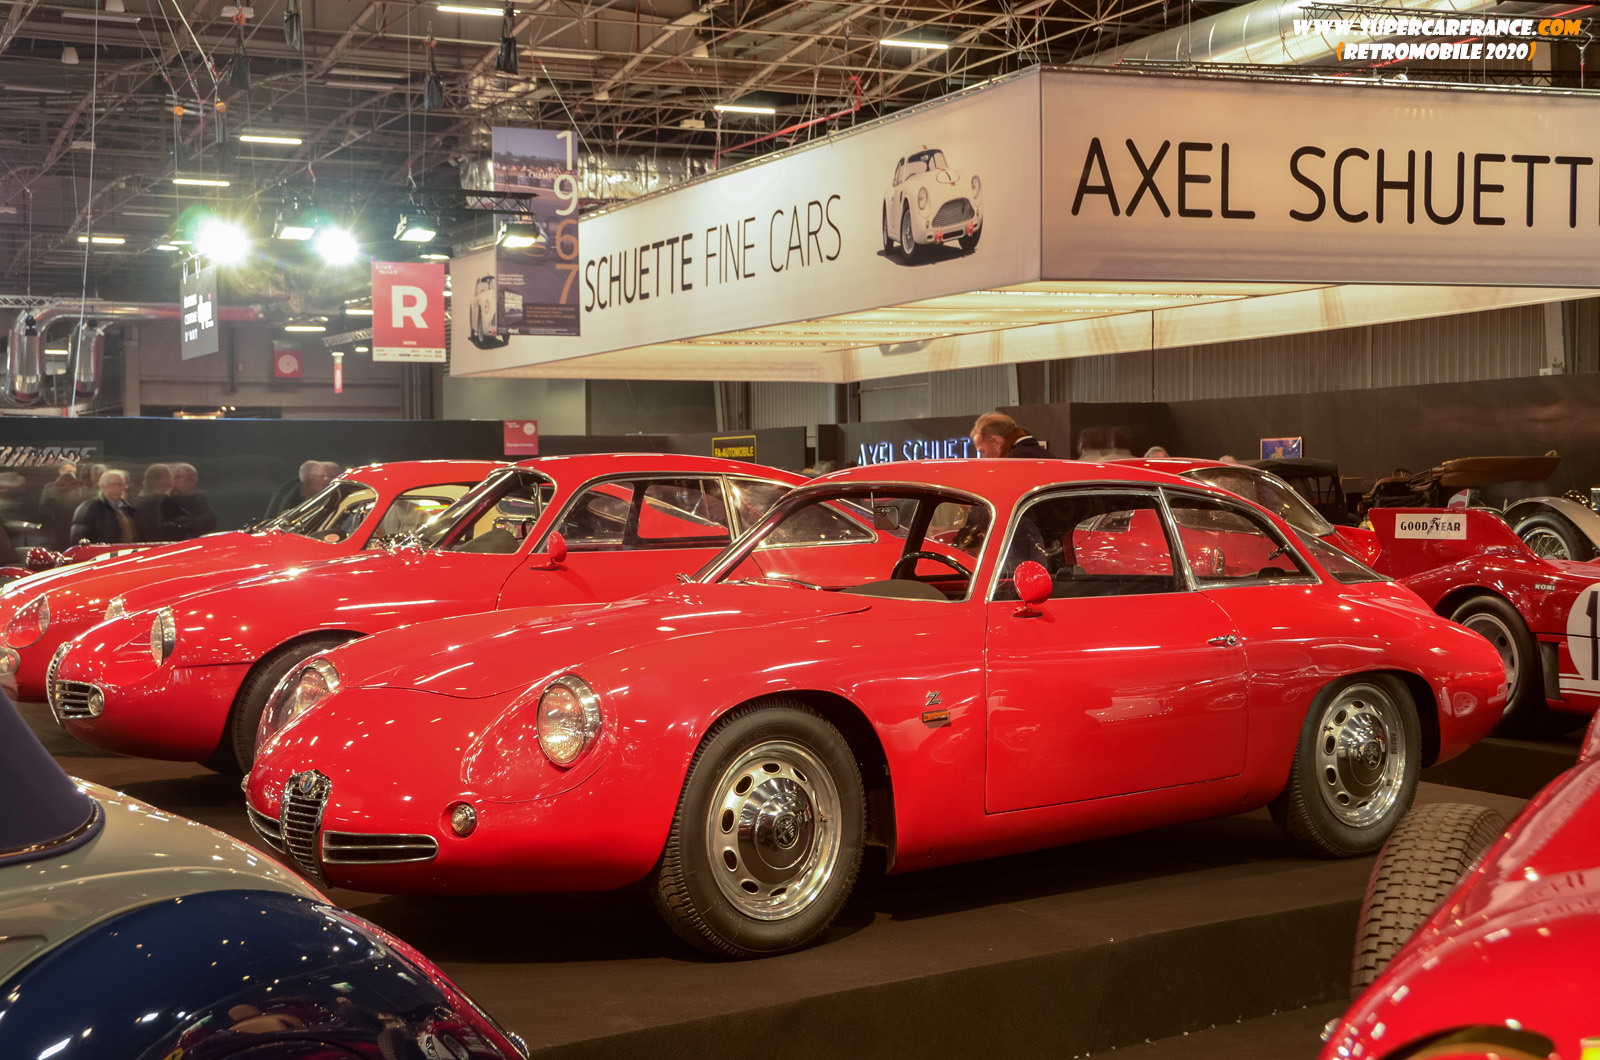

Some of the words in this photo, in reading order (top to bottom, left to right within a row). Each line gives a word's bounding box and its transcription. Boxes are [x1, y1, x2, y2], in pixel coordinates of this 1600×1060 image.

[1070, 137, 1255, 219] AXEL
[1289, 145, 1600, 228] SCHUETT
[584, 233, 694, 313] SCHUETTE
[705, 217, 755, 288] FINE
[769, 194, 842, 275] CARS
[391, 285, 429, 329] R
[714, 446, 754, 458] FA-AUTOMOBILE
[1534, 583, 1556, 591] KONI
